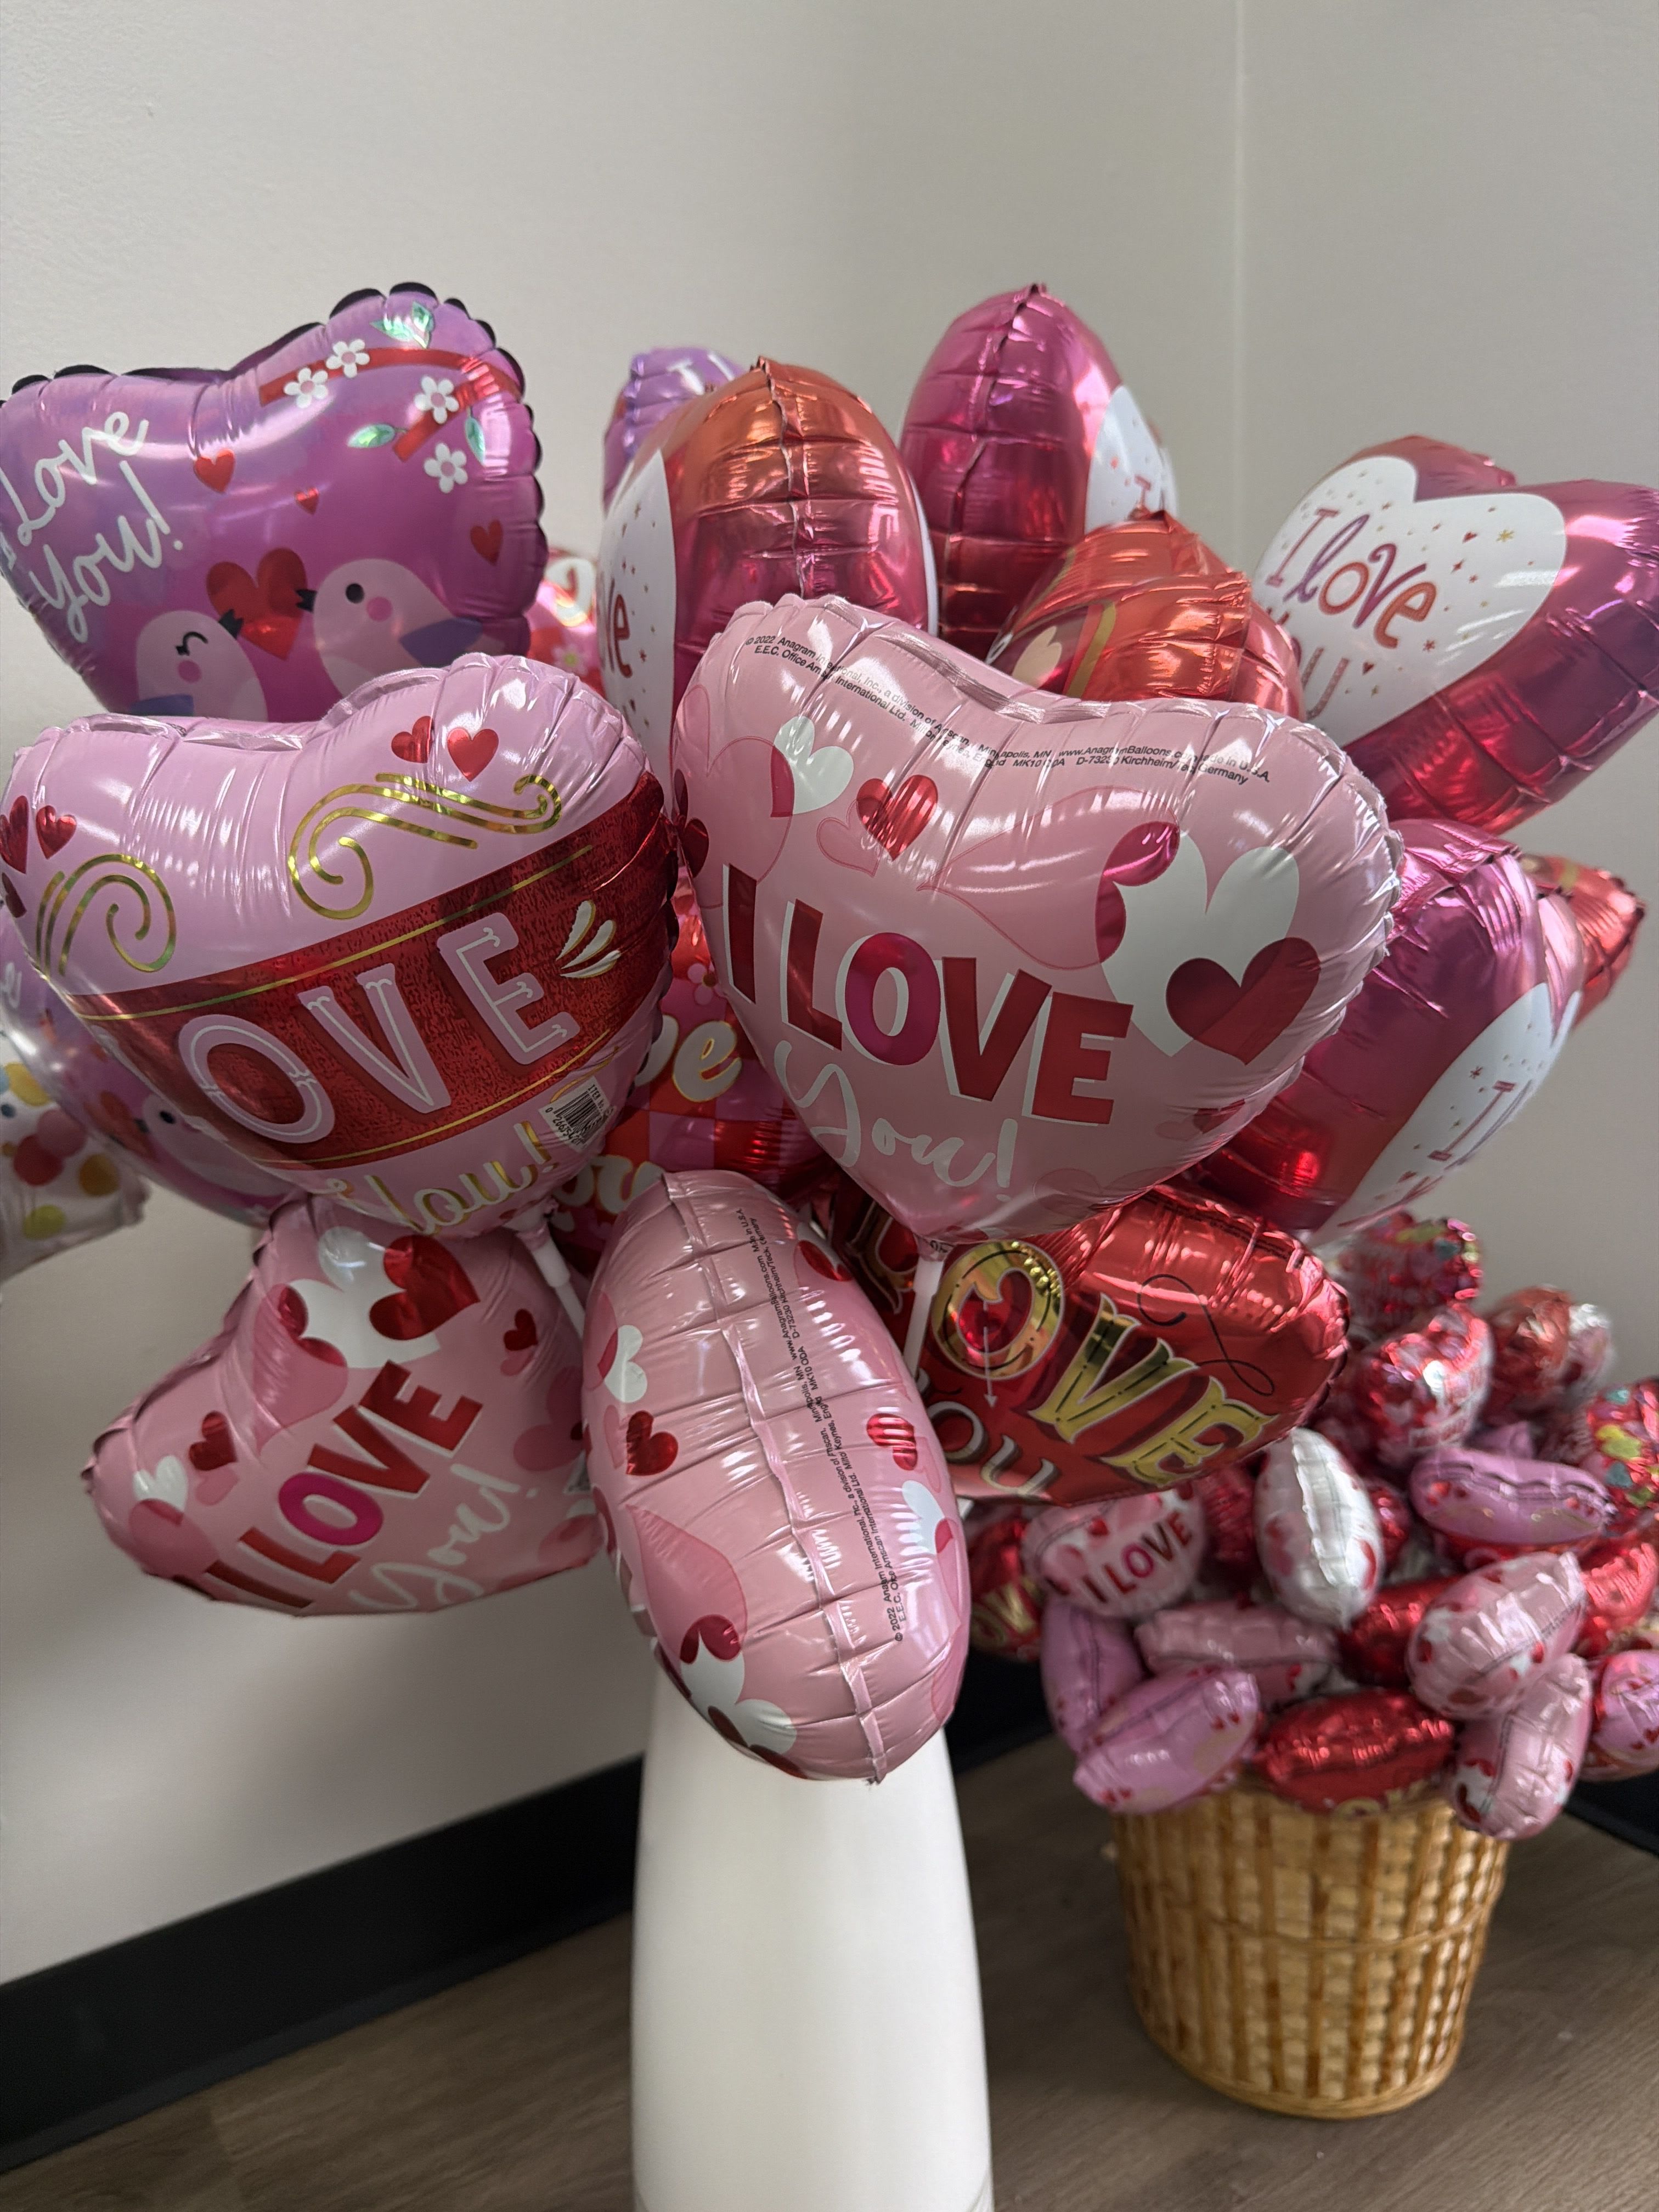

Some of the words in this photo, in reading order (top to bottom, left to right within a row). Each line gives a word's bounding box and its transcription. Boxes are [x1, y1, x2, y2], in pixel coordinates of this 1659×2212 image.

[754, 635, 776, 644] 2022
[777, 637, 816, 659] Anagram
[891, 692, 924, 720] division
[924, 716, 937, 726] of
[1033, 749, 1052, 758] MN
[1200, 754, 1224, 763] ade
[754, 645, 779, 656] E.E.C.
[782, 649, 807, 666] Office
[835, 675, 890, 710] International
[936, 734, 970, 758] eynes,
[723, 864, 757, 1004] I
[781, 899, 1133, 1125] LOVE
[170, 912, 580, 1143] OVE
[782, 1304, 800, 1340] D-73230
[793, 1365, 805, 1381] MN
[804, 1365, 819, 1391] MK10
[800, 1382, 822, 1423] Minpolis,
[238, 1359, 484, 1587] LOVE
[836, 1466, 855, 1494] division
[839, 1450, 852, 1470] Milto
[857, 1487, 881, 1534] International
[856, 1516, 882, 1570] International,
[874, 1536, 893, 1568] Amscan
[1104, 1510, 1192, 1595] LOVE
[877, 1569, 892, 1602] Anaam
[886, 1607, 900, 1632] 2022
